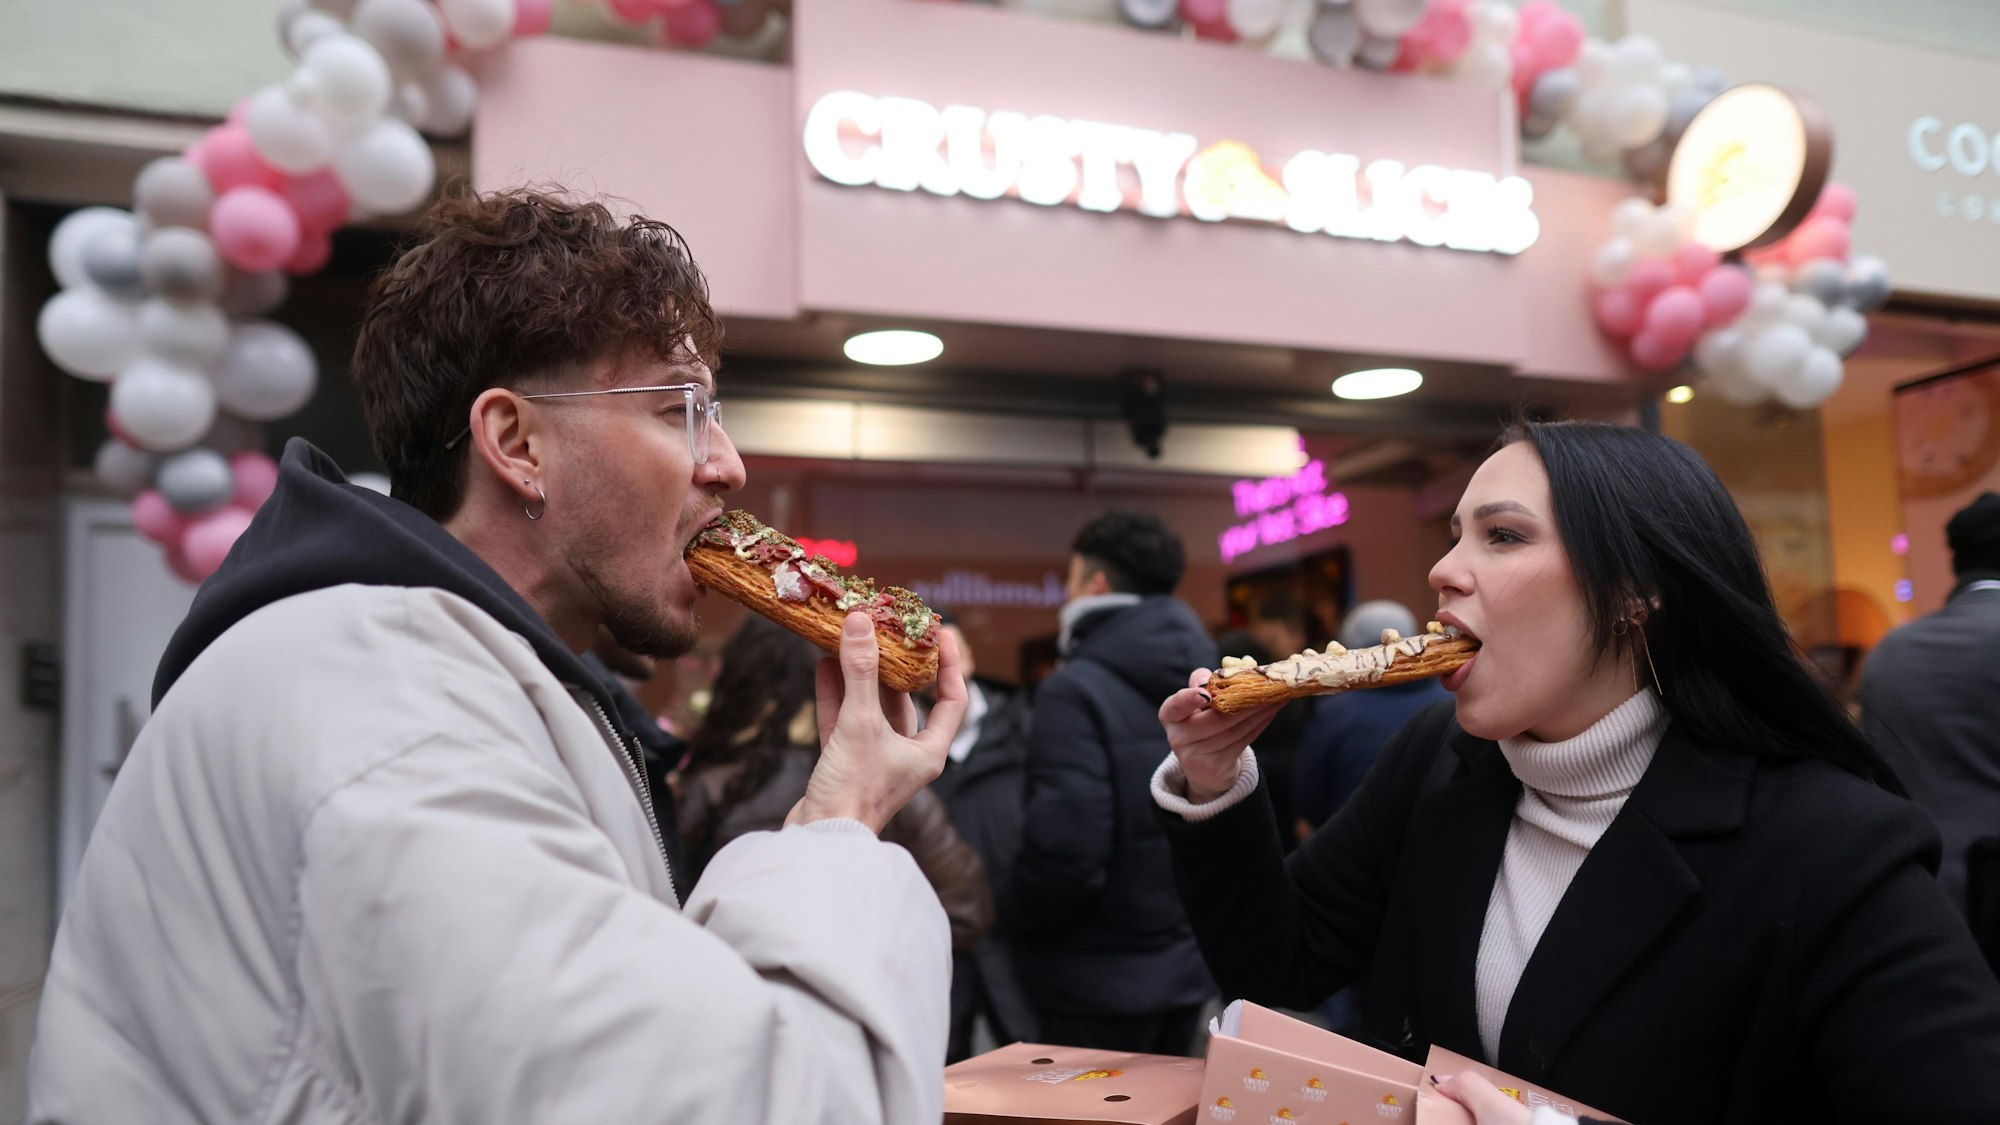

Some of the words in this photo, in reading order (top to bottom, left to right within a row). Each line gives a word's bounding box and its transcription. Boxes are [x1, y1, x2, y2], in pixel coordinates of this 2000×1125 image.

[803, 90, 1199, 216] CRUSTY
[1283, 149, 1540, 254] SLICES
[1243, 1076, 1270, 1088] CRUSTY
[1210, 1104, 1236, 1117] CRUSTY
